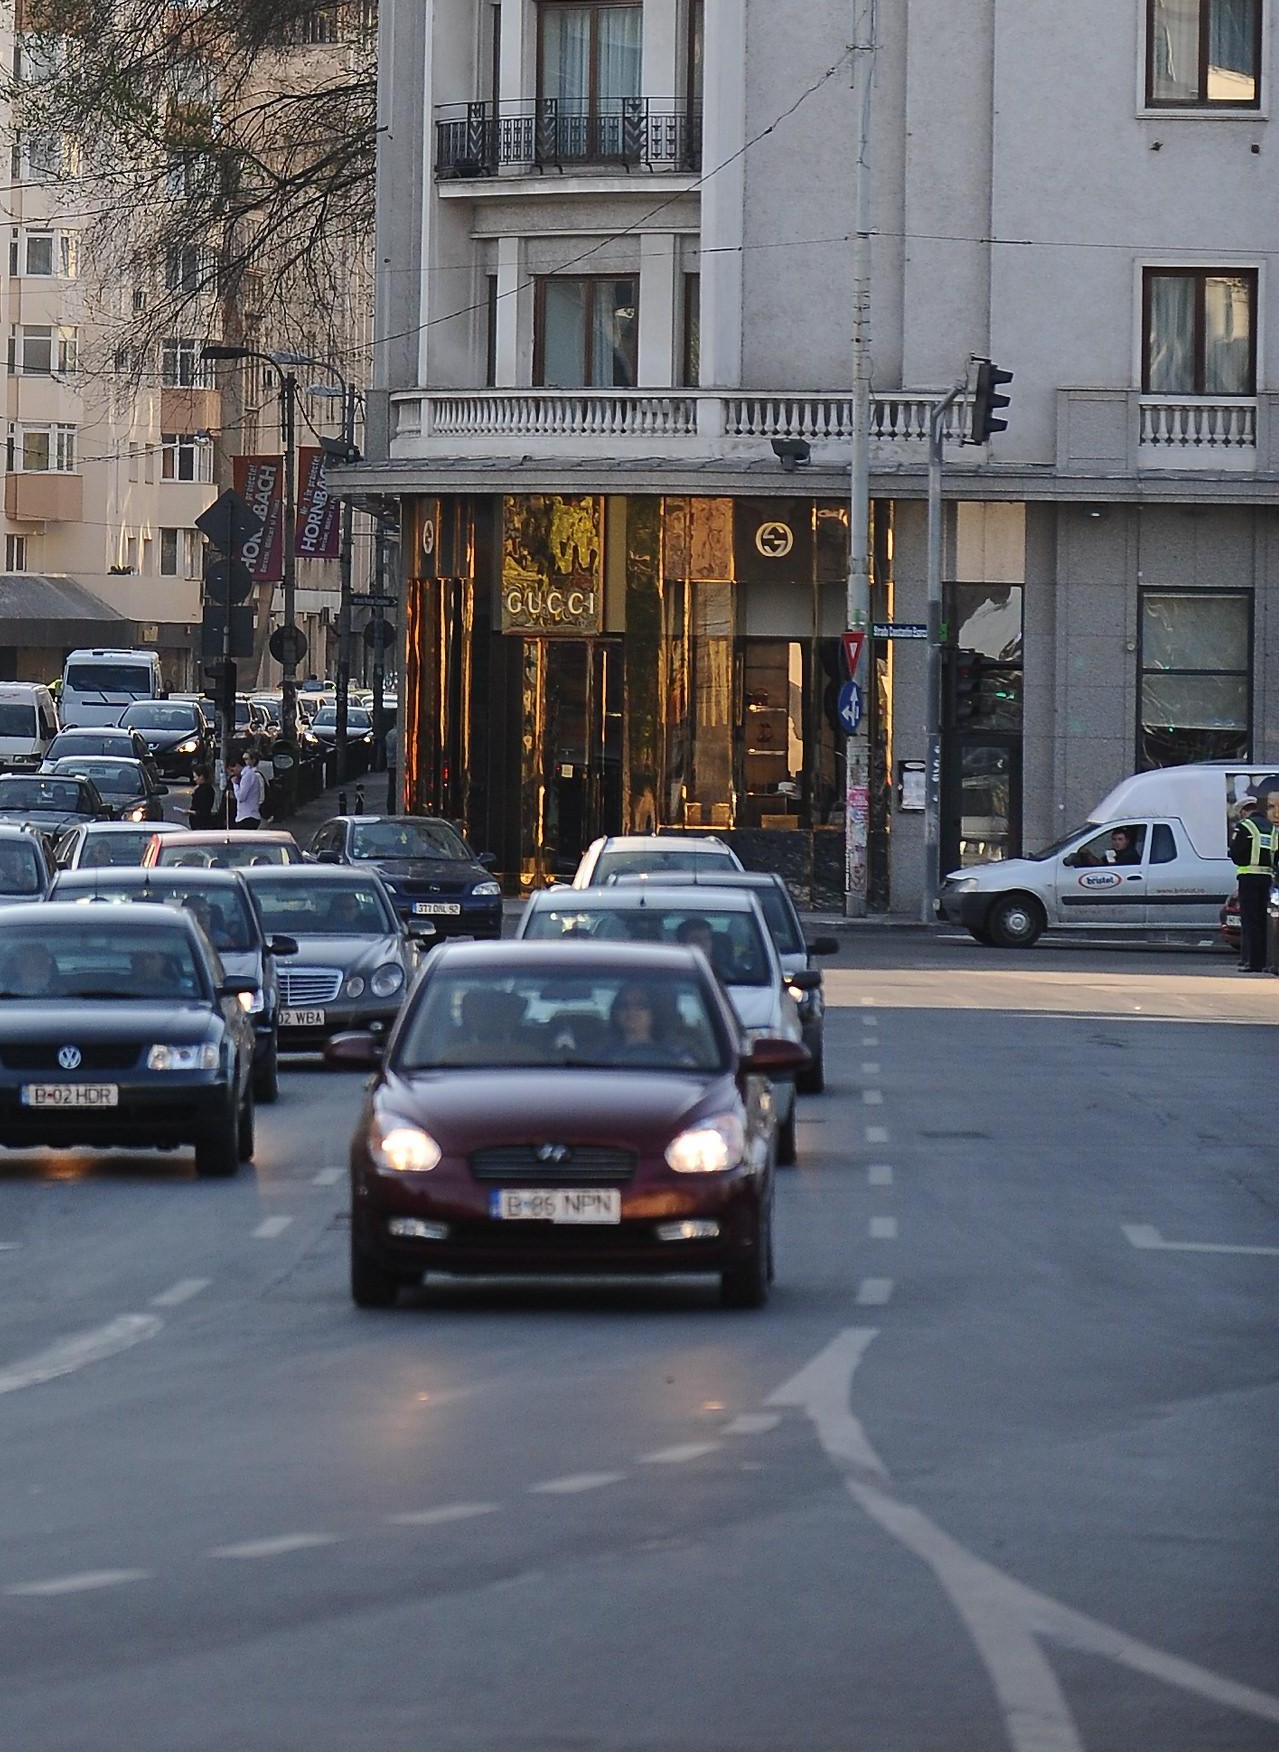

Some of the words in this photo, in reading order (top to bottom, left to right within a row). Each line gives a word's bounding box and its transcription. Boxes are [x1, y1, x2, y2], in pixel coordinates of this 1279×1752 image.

[508, 592, 594, 614] GUCCI
[1086, 876, 1114, 885] bristol
[296, 1011, 323, 1024] WBA
[76, 1088, 111, 1104] HDR
[565, 1194, 612, 1214] NPN
